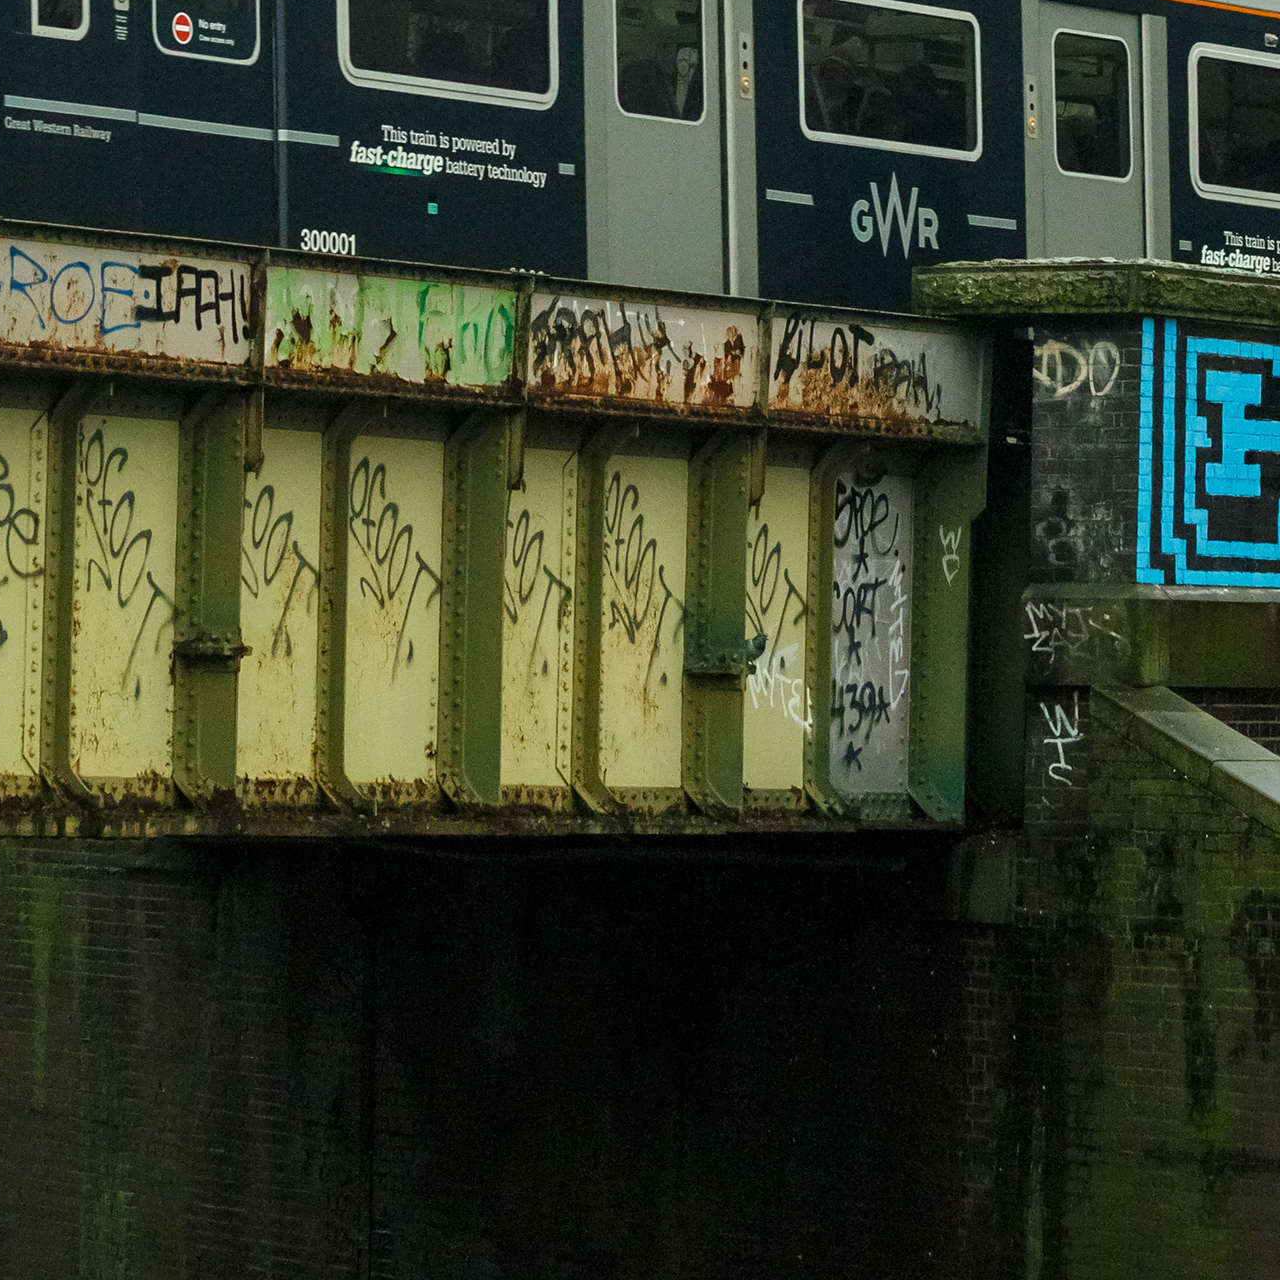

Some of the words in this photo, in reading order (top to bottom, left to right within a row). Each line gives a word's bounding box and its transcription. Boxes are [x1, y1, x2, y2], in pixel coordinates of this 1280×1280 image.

[4, 116, 31, 130] Great
[32, 119, 72, 136] Western
[72, 124, 112, 143] Railway
[381, 124, 408, 144] This
[409, 129, 438, 148] train
[439, 132, 450, 149] is
[451, 136, 500, 155] powered
[501, 139, 517, 160] by
[349, 140, 444, 175] fast-charge
[445, 157, 486, 180] battery
[487, 163, 548, 188] technology
[850, 171, 940, 260] GWR
[300, 228, 357, 255] 300001
[1223, 230, 1244, 247] This
[1244, 234, 1266, 250] train
[1266, 236, 1276, 251] is
[1200, 245, 1271, 272] fast-charge
